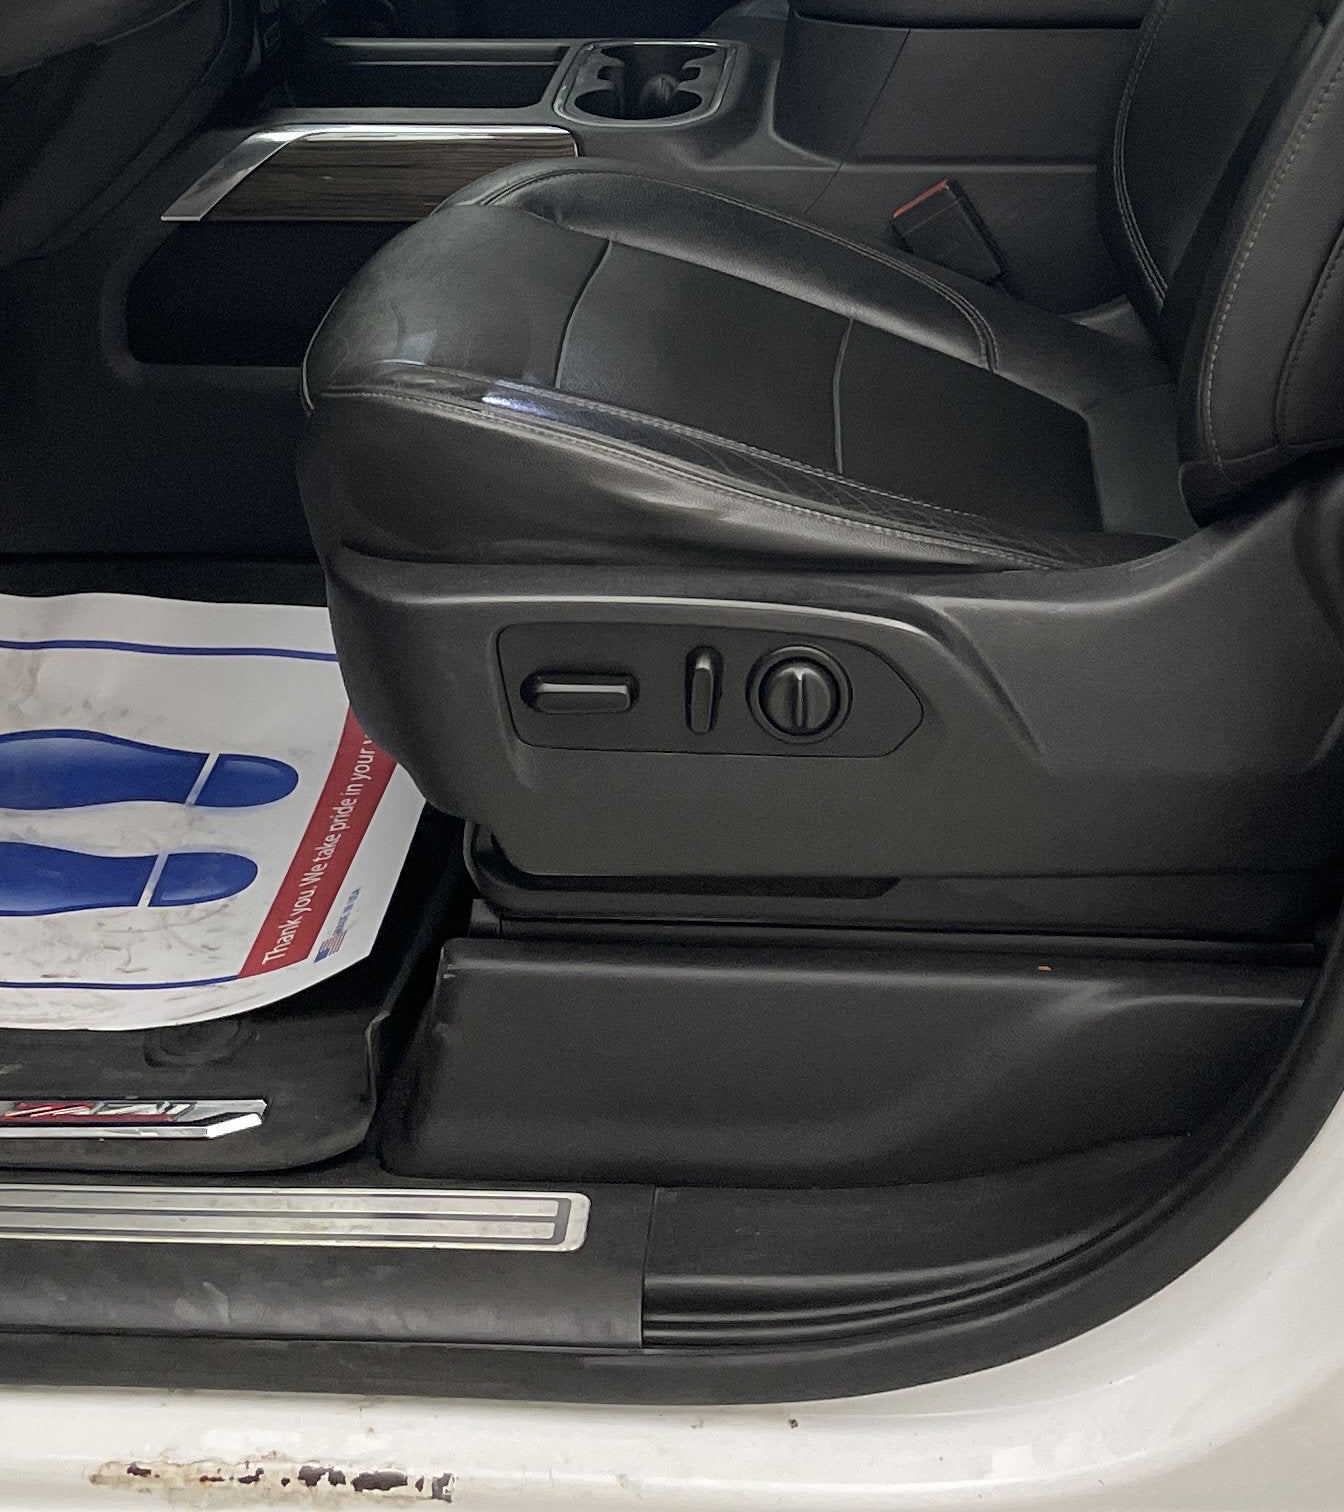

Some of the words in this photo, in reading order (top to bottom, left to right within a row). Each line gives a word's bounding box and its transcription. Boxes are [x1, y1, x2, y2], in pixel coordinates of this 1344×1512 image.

[350, 748, 376, 781] your
[339, 783, 364, 796] in
[329, 798, 358, 832] pride
[312, 833, 342, 862] take
[298, 863, 328, 887] We
[261, 916, 303, 965] Thank
